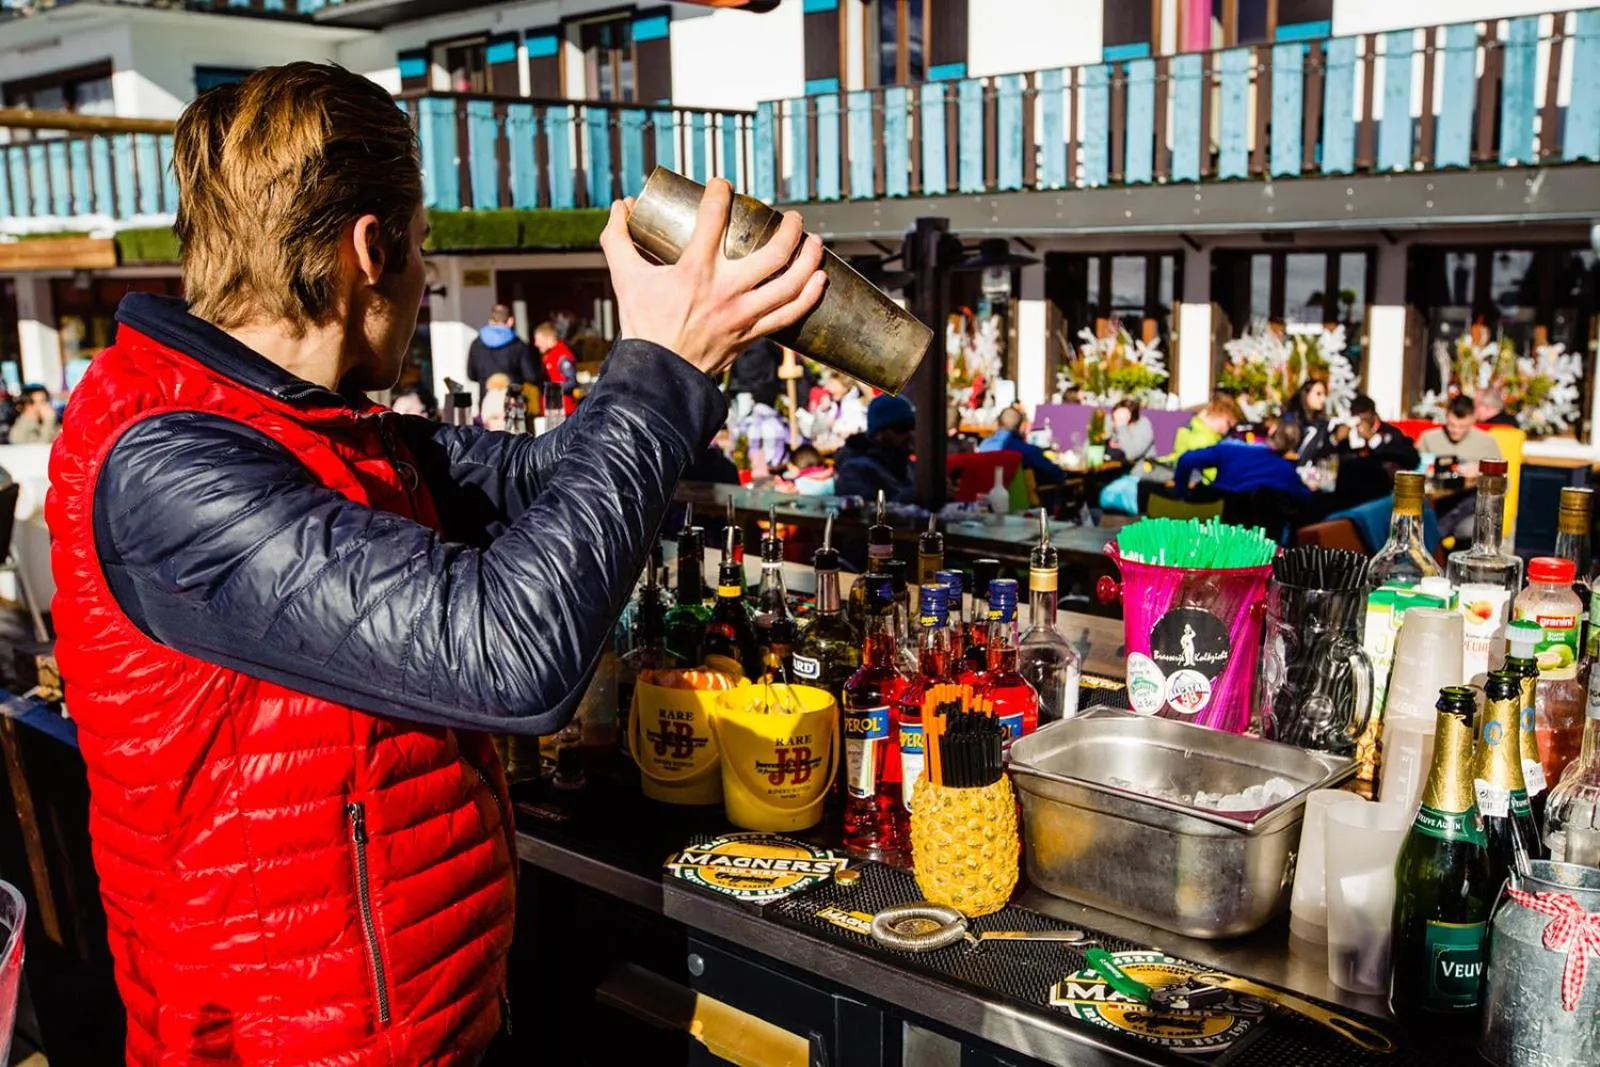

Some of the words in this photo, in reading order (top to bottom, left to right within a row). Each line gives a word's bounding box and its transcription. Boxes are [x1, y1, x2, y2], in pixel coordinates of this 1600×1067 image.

[1540, 616, 1573, 627] granini
[658, 708, 695, 721] RARE
[775, 734, 813, 747] RARE
[678, 852, 834, 874] MAGNERS
